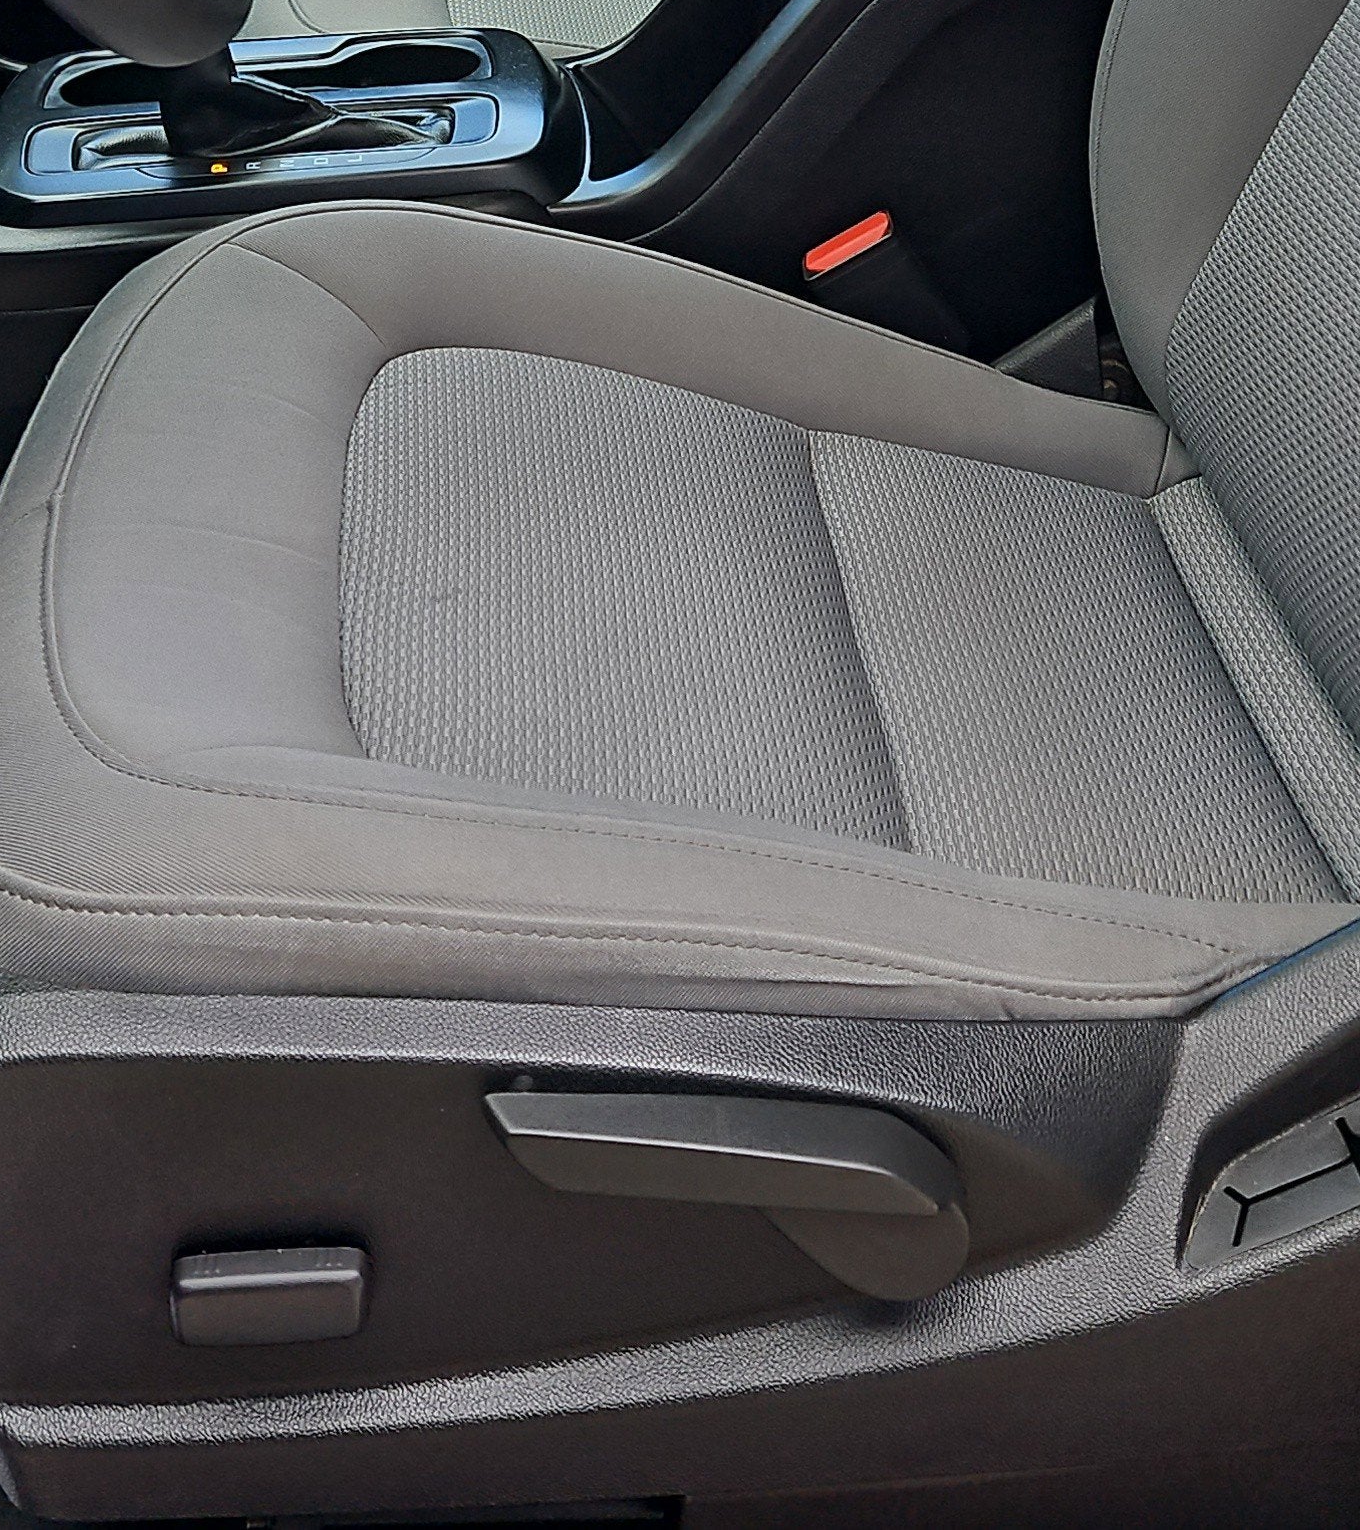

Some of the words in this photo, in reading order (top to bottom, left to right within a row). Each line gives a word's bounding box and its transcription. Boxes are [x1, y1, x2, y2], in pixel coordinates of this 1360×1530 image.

[210, 162, 229, 174] P
[245, 160, 262, 171] R
[313, 156, 329, 166] D
[347, 154, 363, 163] L
